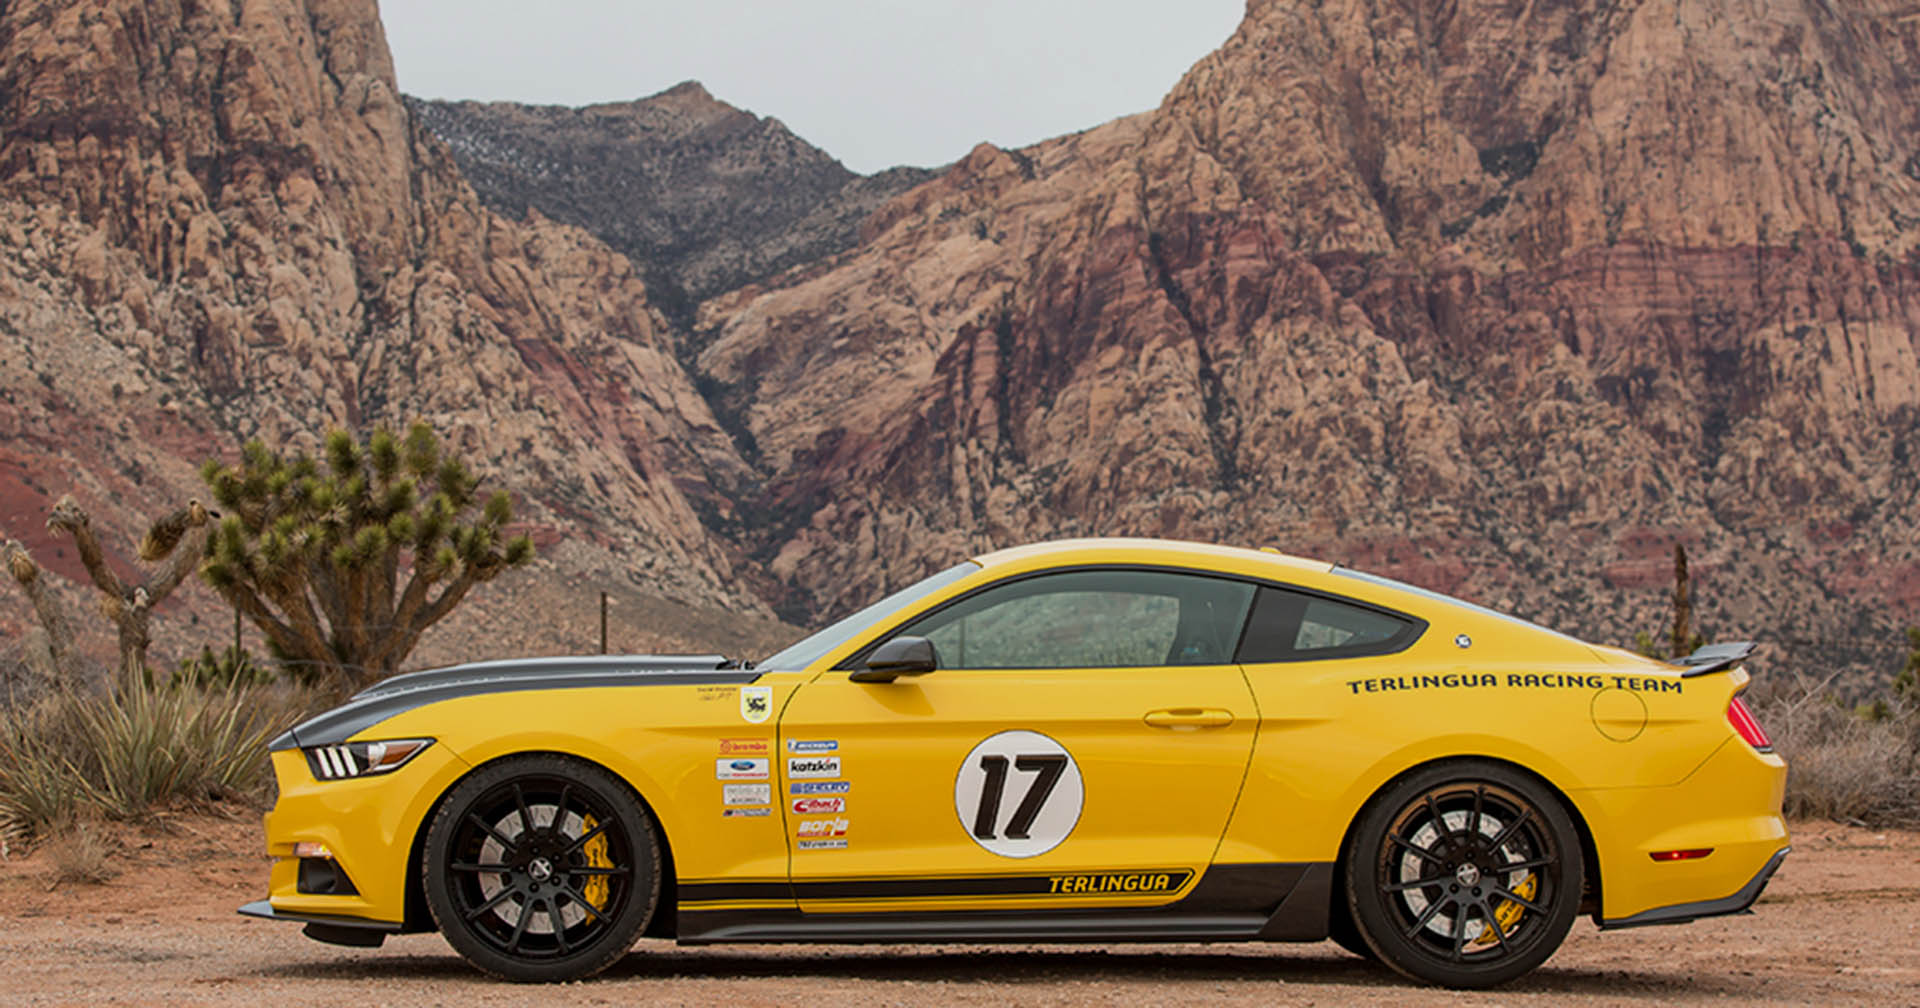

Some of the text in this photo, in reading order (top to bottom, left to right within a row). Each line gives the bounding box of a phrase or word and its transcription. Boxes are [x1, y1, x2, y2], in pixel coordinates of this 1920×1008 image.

[1347, 674, 1683, 694] TERLINGUA RACING TEAM
[791, 758, 837, 772] katzkin
[974, 754, 1068, 840] 17
[1049, 874, 1170, 893] TERLINGUA
